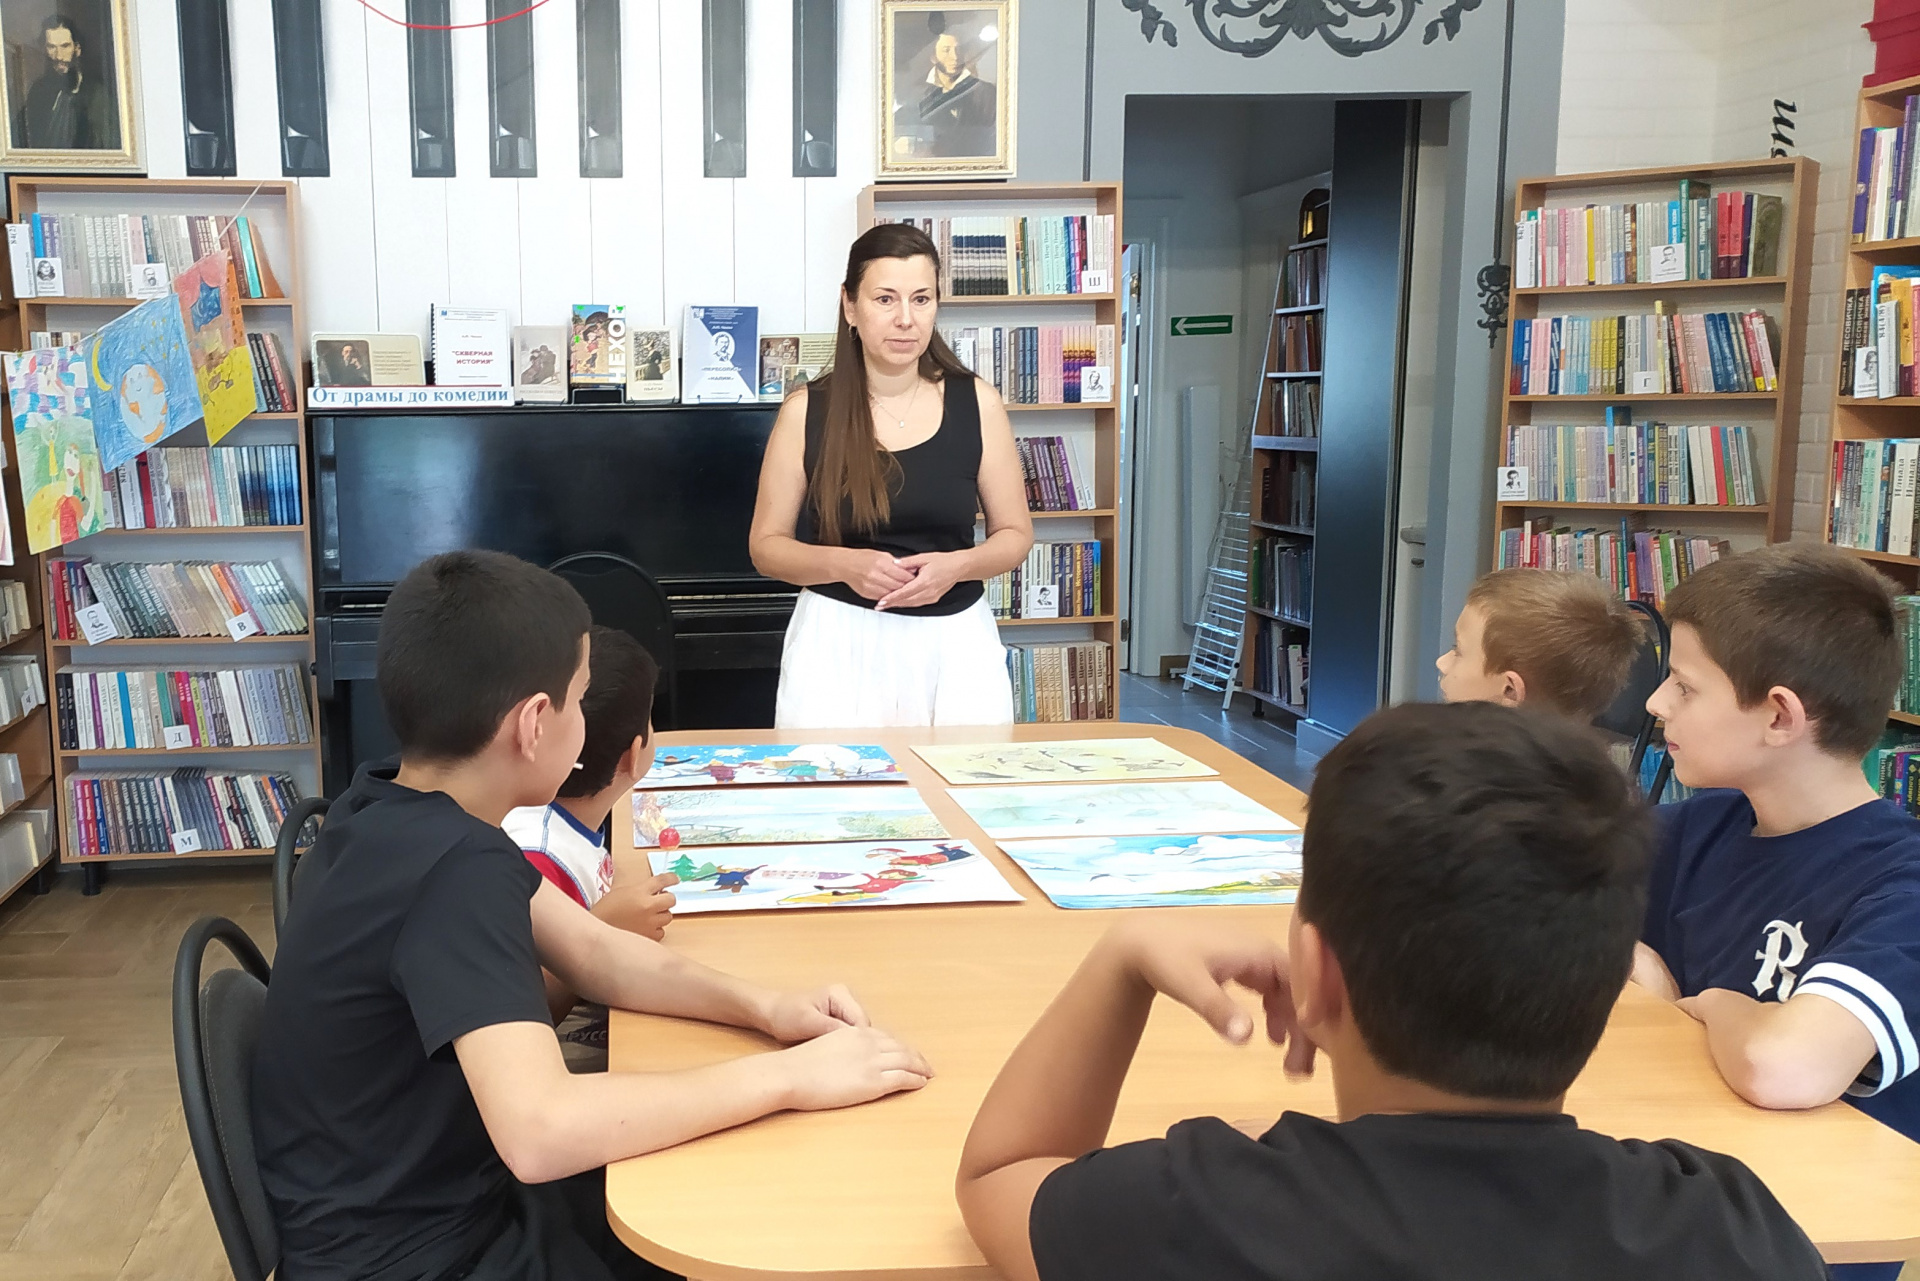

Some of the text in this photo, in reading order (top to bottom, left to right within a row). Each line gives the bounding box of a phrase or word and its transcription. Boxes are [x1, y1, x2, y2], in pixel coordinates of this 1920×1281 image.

[84, 218, 96, 257] ОБЛОМОВ
[94, 217, 106, 257] ОБЛОМОВ
[103, 217, 114, 257] ОБЛОМОВ
[111, 217, 121, 257] ОБЛОМОВ
[1089, 277, 1101, 286] Ш
[1843, 296, 1854, 351] ЛЕСОВИЧКА
[608, 305, 626, 383] ЧЕХОВ
[313, 388, 509, 406] От драмы до комедии
[1643, 378, 1651, 388] Г
[1894, 458, 1905, 497] Илиада
[1906, 458, 1916, 497] Илиада
[239, 622, 247, 631] В
[180, 836, 193, 847] М
[1751, 919, 1809, 1003] R
